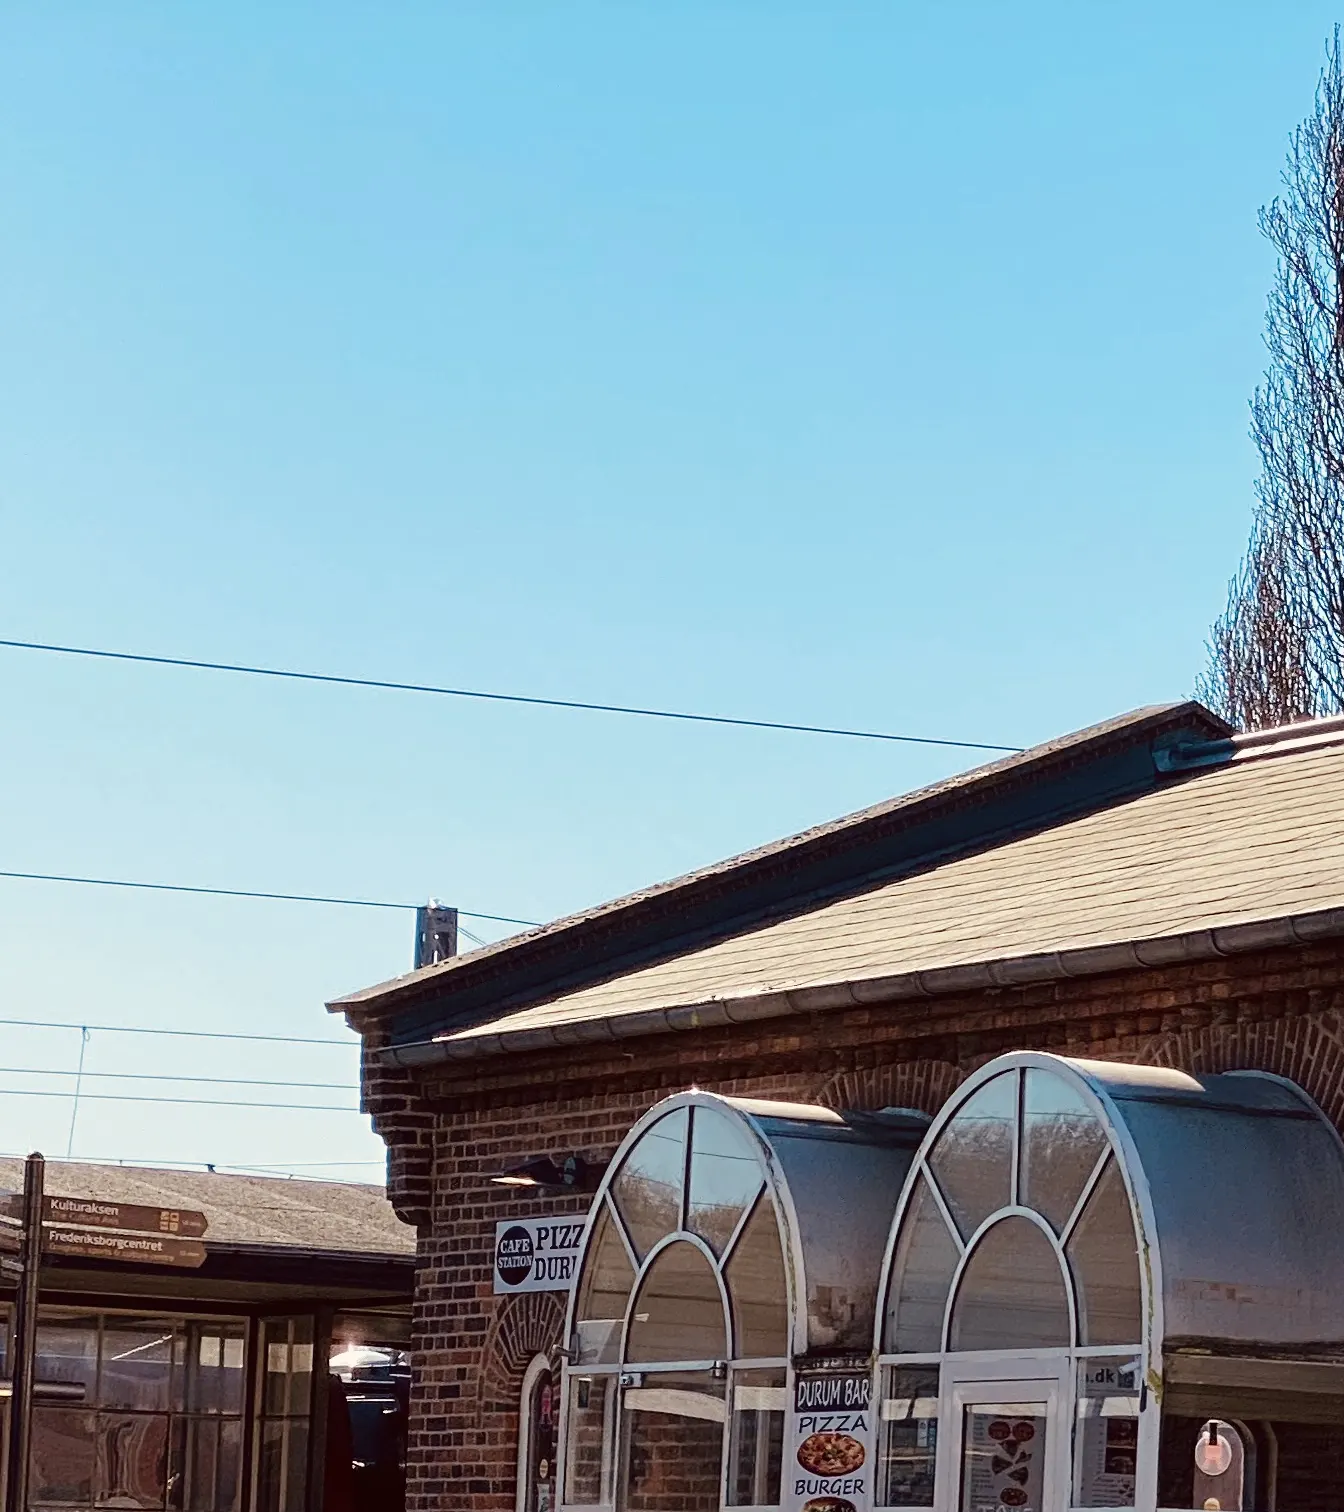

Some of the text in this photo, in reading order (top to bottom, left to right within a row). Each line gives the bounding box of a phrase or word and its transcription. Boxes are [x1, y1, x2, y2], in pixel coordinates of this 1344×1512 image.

[51, 1200, 119, 1216] Kulturaksen
[50, 1230, 163, 1251] Frederiksborgcentret
[536, 1223, 586, 1250] PIZZ
[500, 1239, 530, 1253] CAFE
[497, 1254, 533, 1268] STATION
[534, 1256, 578, 1280] DUR
[798, 1378, 869, 1408] DURUM BAR
[799, 1415, 868, 1433] PIZZA
[795, 1478, 865, 1495] BURGER
